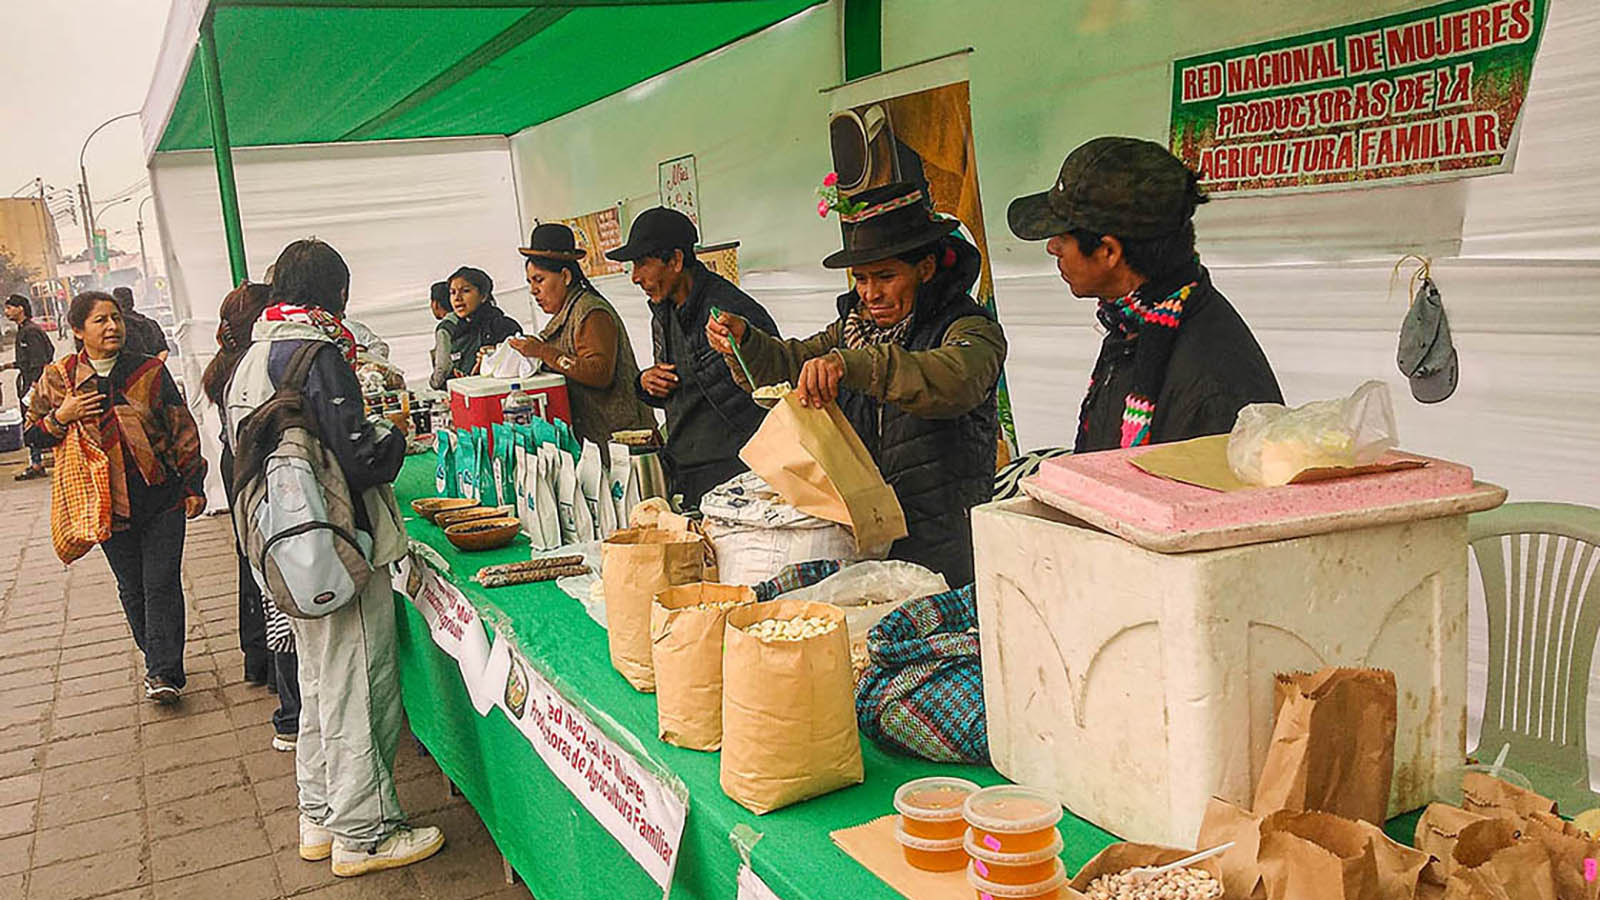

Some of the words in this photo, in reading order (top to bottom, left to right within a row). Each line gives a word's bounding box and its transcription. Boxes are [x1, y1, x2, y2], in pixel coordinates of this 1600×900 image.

[1184, 64, 1223, 101] RED
[1226, 41, 1342, 94] NACIONAL
[1348, 33, 1382, 74] DE
[1385, 0, 1532, 67] MUJERES
[1217, 81, 1391, 137] PRODUCTORAS
[1394, 74, 1433, 113] DE
[1436, 65, 1473, 106] LA
[1199, 133, 1354, 182] AGRICULTURA
[1360, 113, 1499, 167] FAMILIAR
[545, 694, 563, 726] ed
[570, 748, 587, 774] de
[584, 759, 633, 824] Agricultura
[633, 807, 674, 867] Familiar
